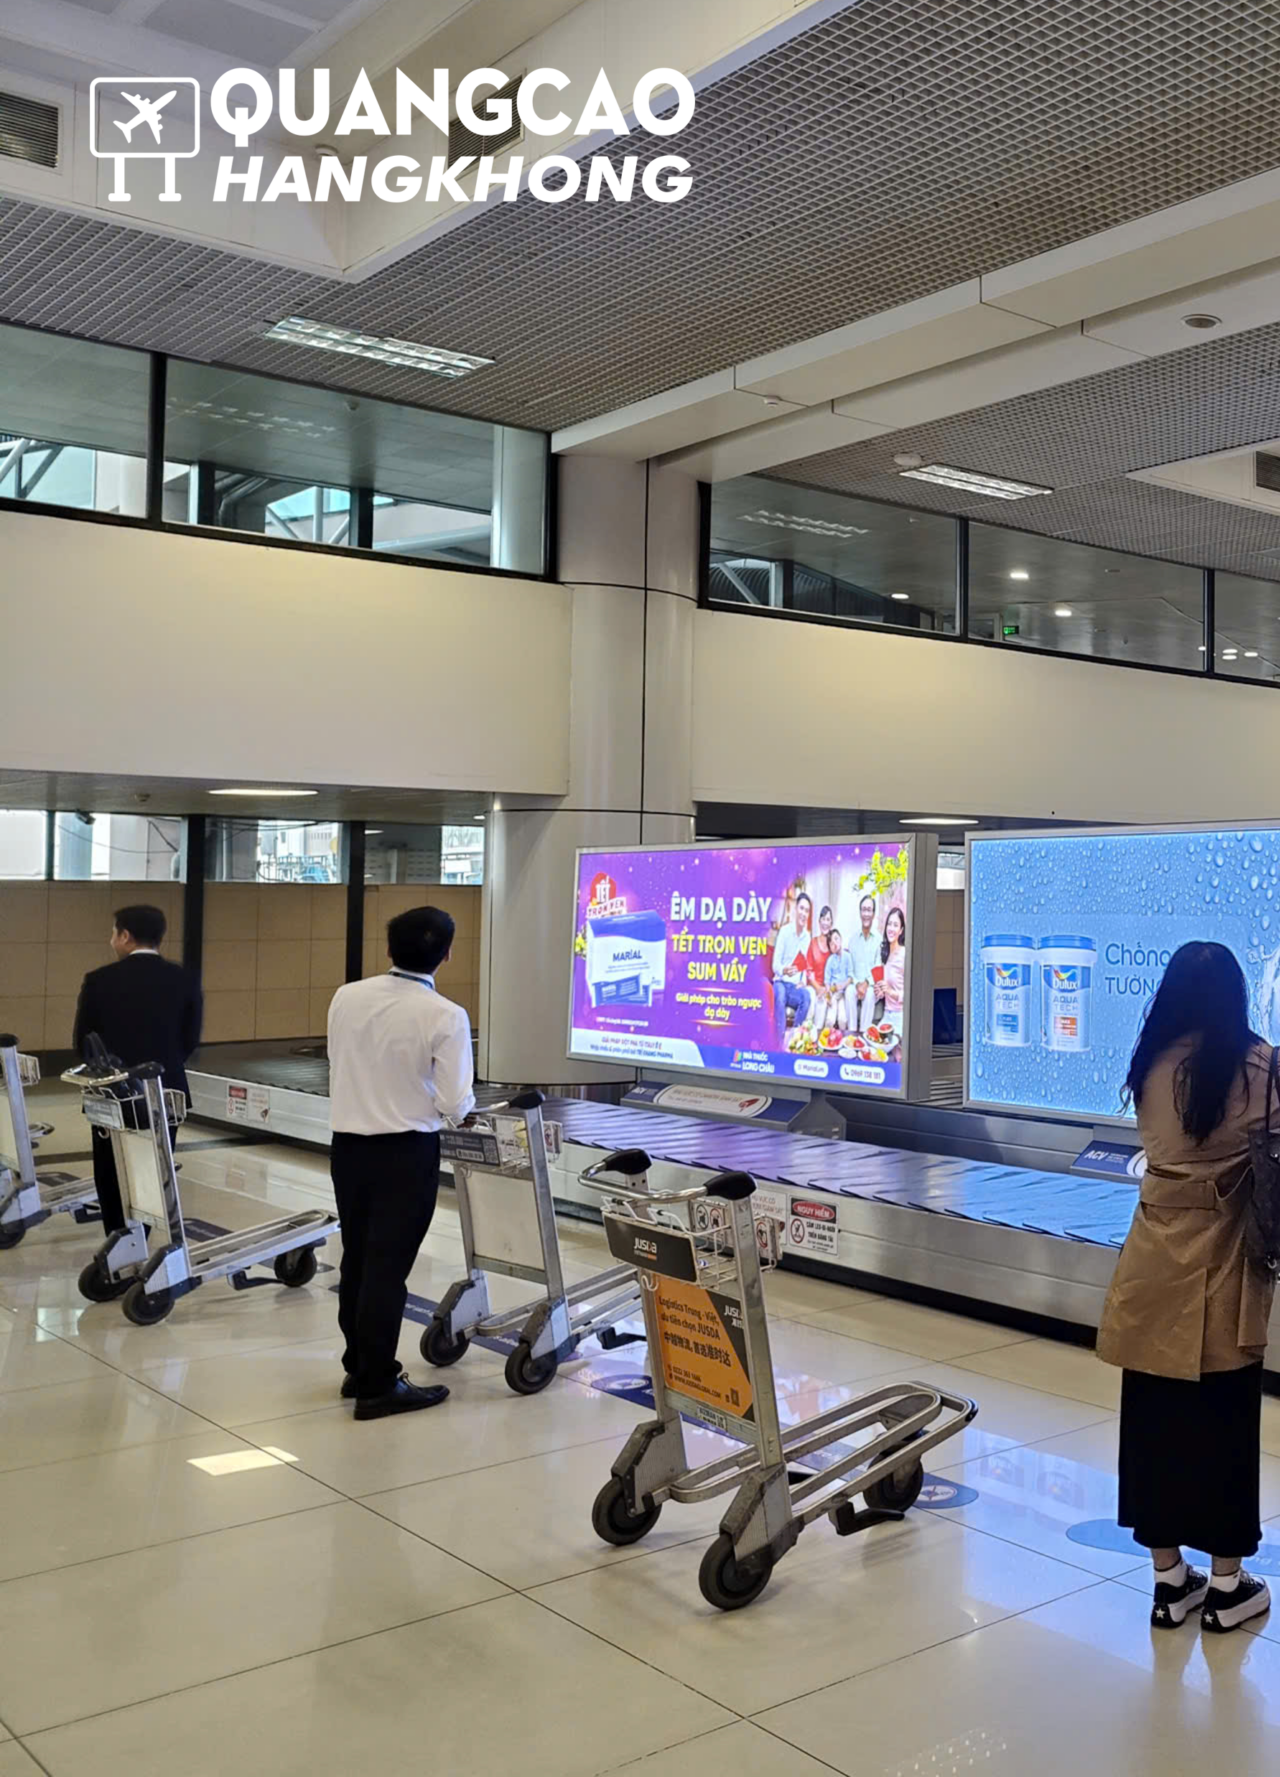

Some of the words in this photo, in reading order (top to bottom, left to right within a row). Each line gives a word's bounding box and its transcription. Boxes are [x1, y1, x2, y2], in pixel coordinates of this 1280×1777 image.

[670, 891, 696, 921] ÊM
[700, 896, 728, 929] DẠ
[732, 890, 773, 922] DÀY
[672, 925, 695, 953] TẾT
[697, 934, 736, 959] TRỌN
[739, 935, 768, 960] VẸN
[687, 961, 718, 981] SUM
[1084, 1149, 1109, 1161] ACV
